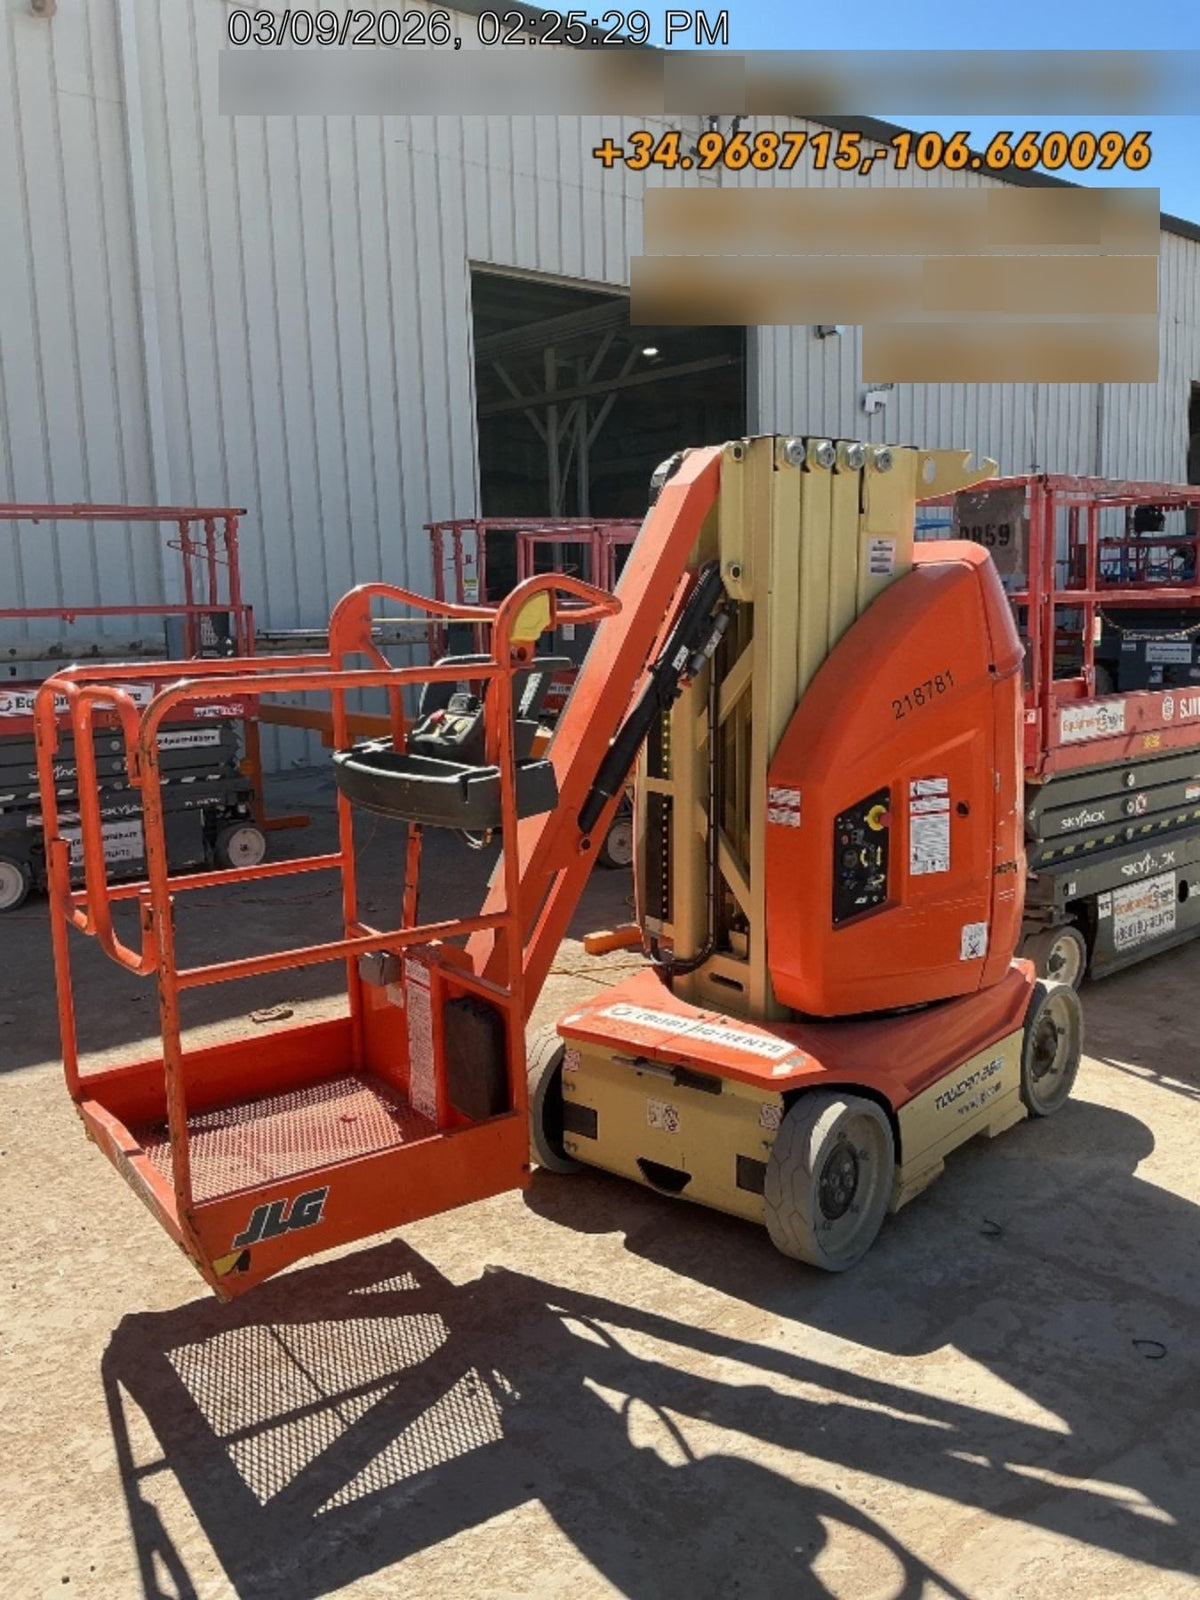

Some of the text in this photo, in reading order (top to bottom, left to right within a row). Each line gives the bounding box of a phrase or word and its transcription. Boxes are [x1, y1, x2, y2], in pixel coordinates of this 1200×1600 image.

[890, 669, 955, 720] 218781
[1060, 810, 1105, 829] SKYJACK
[232, 1186, 330, 1250] JLG
